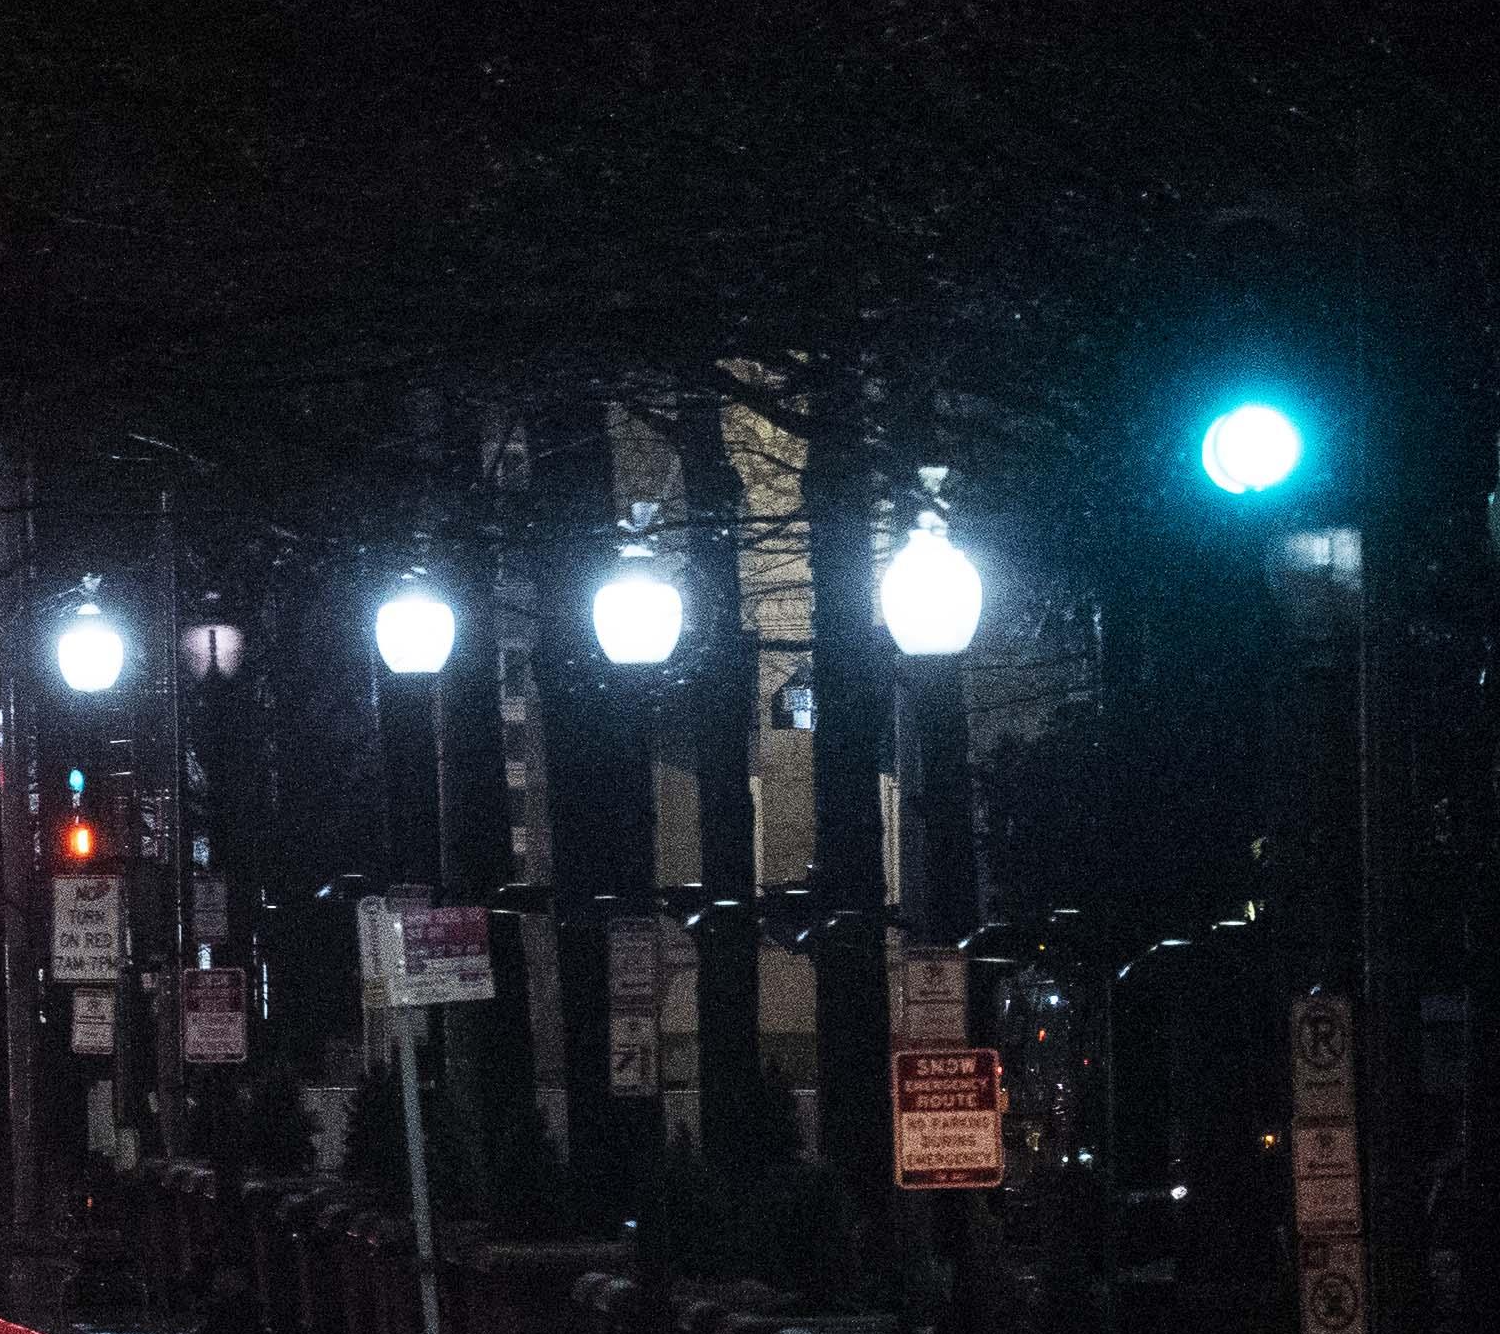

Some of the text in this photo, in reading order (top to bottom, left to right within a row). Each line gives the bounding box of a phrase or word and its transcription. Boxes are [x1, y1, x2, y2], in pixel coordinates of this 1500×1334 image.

[68, 909, 105, 925] TURN
[60, 932, 113, 949] ON RED
[916, 1057, 977, 1076] SNOW
